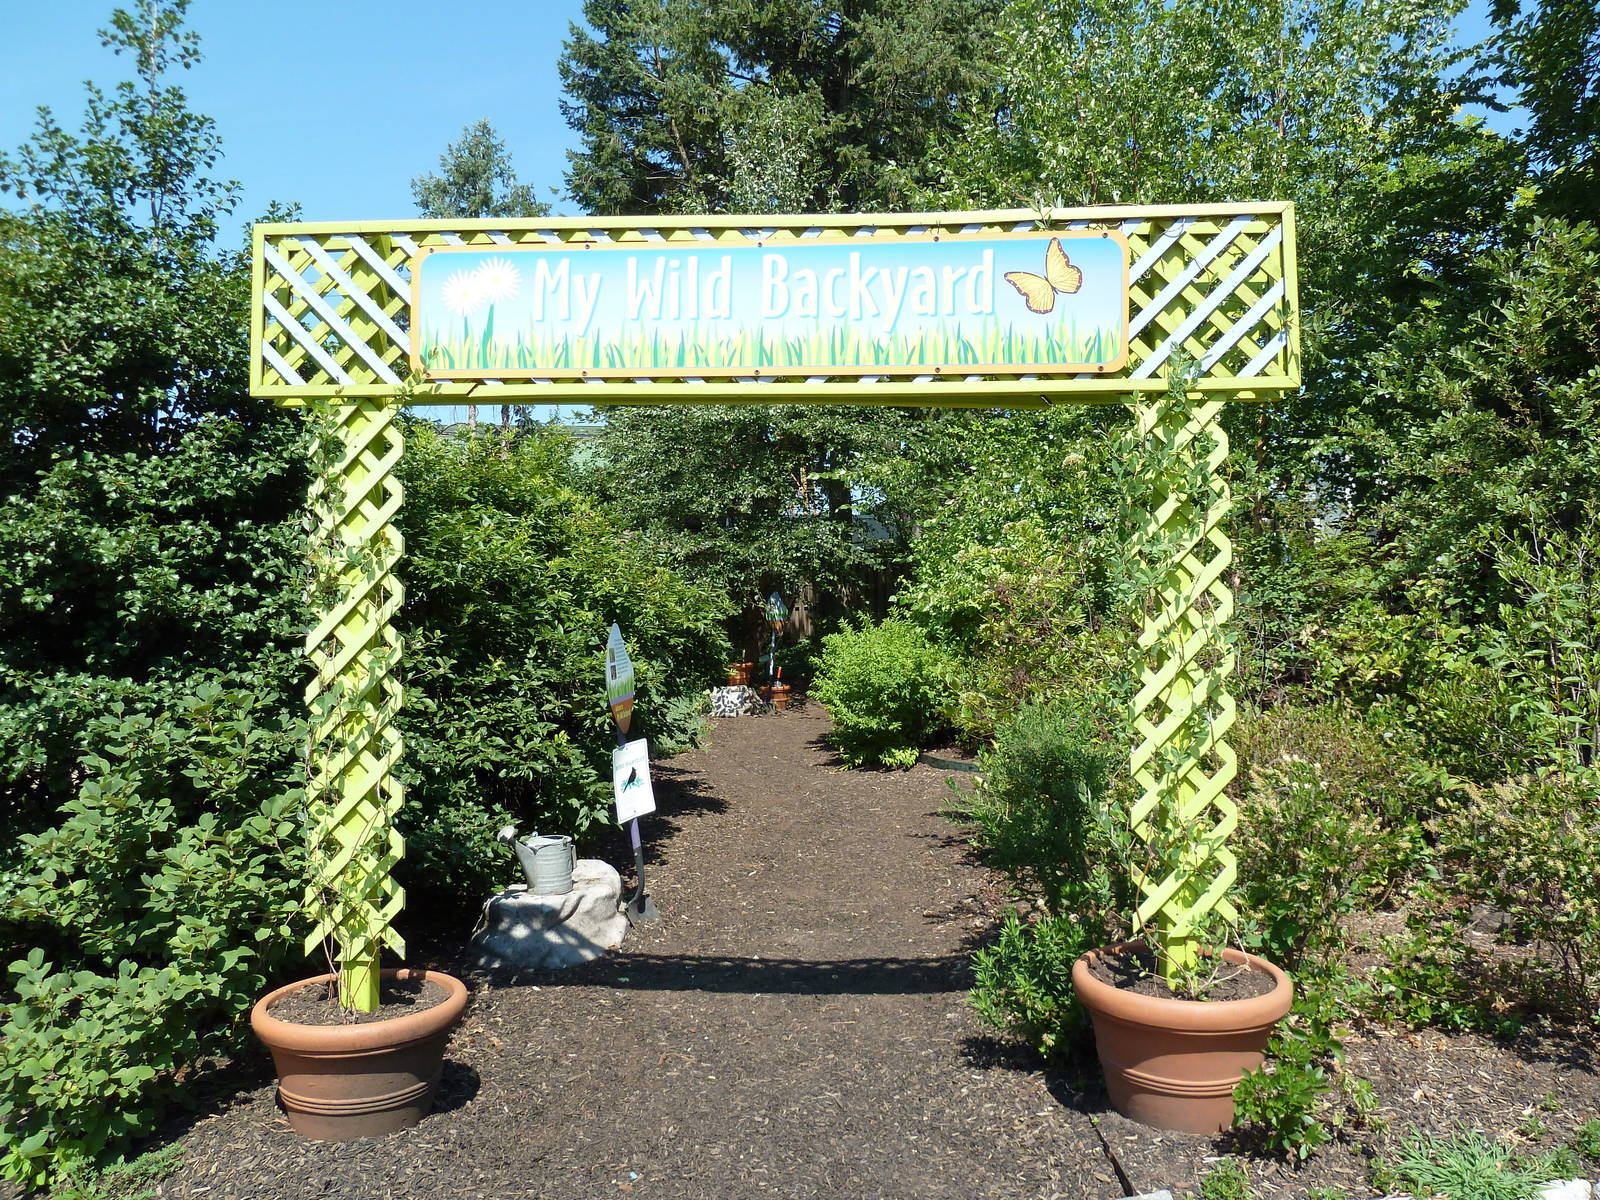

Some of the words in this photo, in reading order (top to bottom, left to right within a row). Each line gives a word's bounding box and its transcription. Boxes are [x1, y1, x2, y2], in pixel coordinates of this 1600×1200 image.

[533, 257, 602, 337] My
[627, 255, 733, 321] Wild
[761, 248, 995, 334] Backyard
